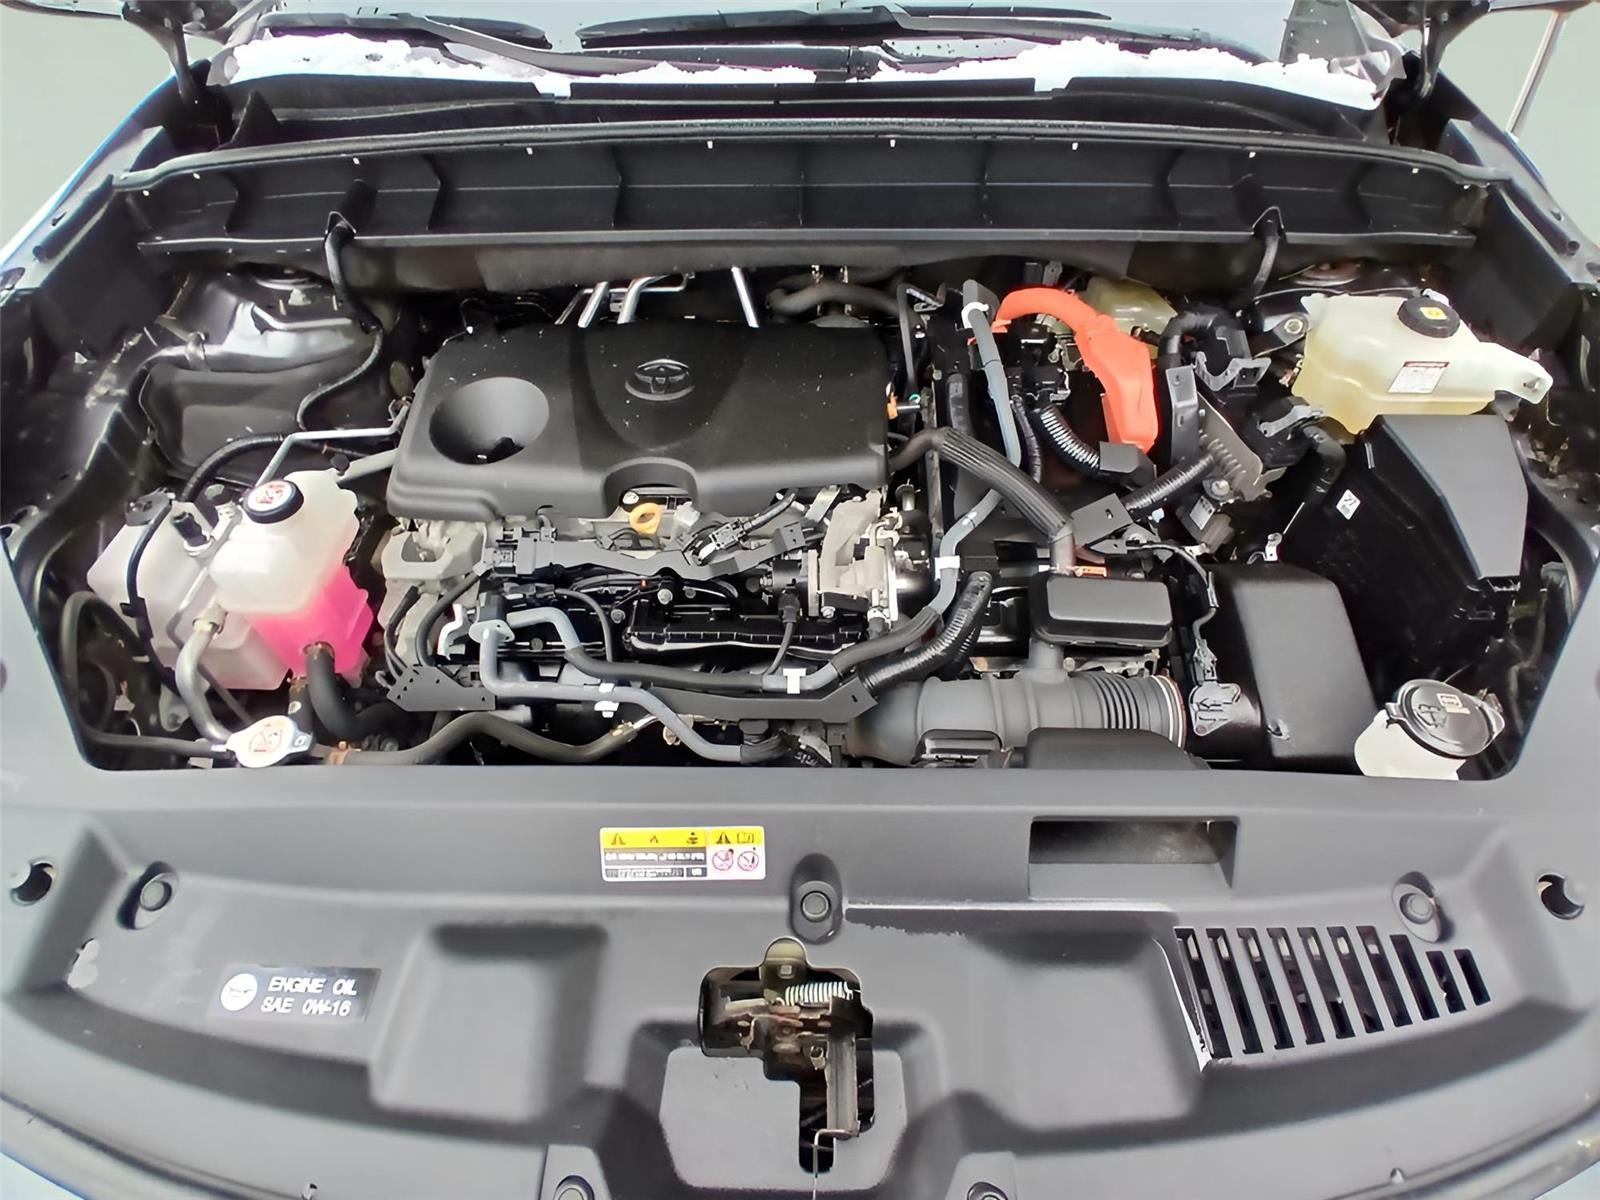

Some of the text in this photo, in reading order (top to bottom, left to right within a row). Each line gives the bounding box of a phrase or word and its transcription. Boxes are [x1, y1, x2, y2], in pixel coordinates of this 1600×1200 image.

[268, 976, 357, 996] ENGINE OIL
[261, 997, 352, 1017] SAE 0W-16
